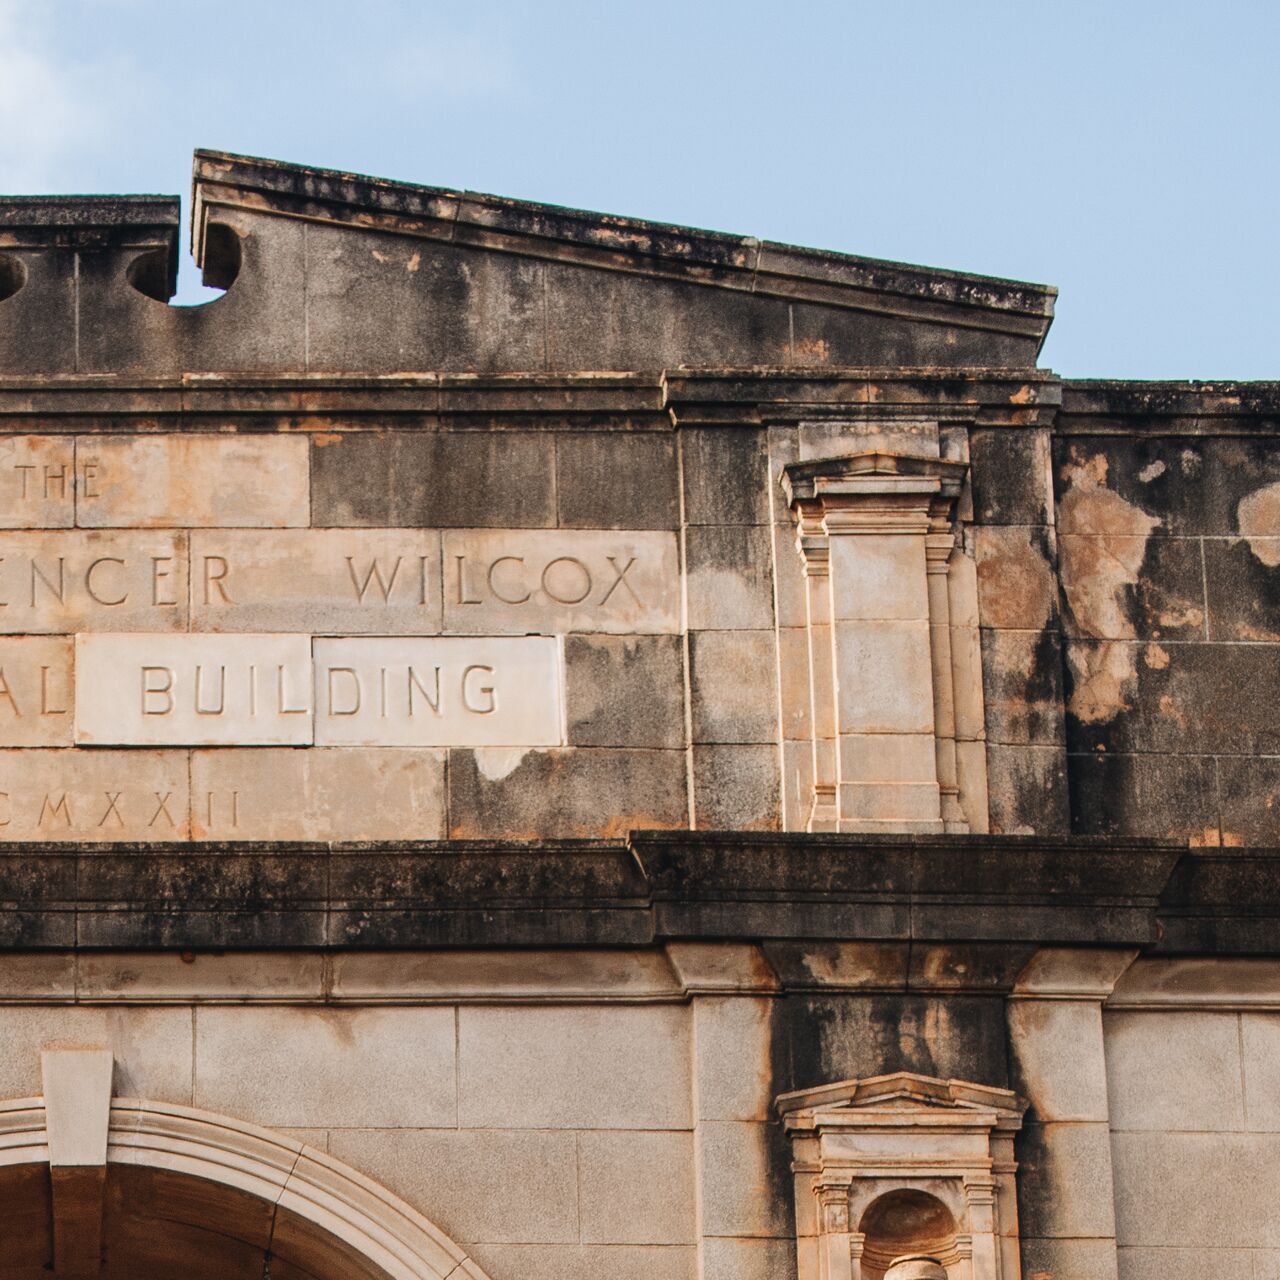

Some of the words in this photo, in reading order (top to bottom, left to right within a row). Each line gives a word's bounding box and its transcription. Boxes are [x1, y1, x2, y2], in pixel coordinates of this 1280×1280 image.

[13, 464, 100, 499] THE
[344, 555, 642, 607] WILCOX
[140, 664, 498, 717] BUILDING
